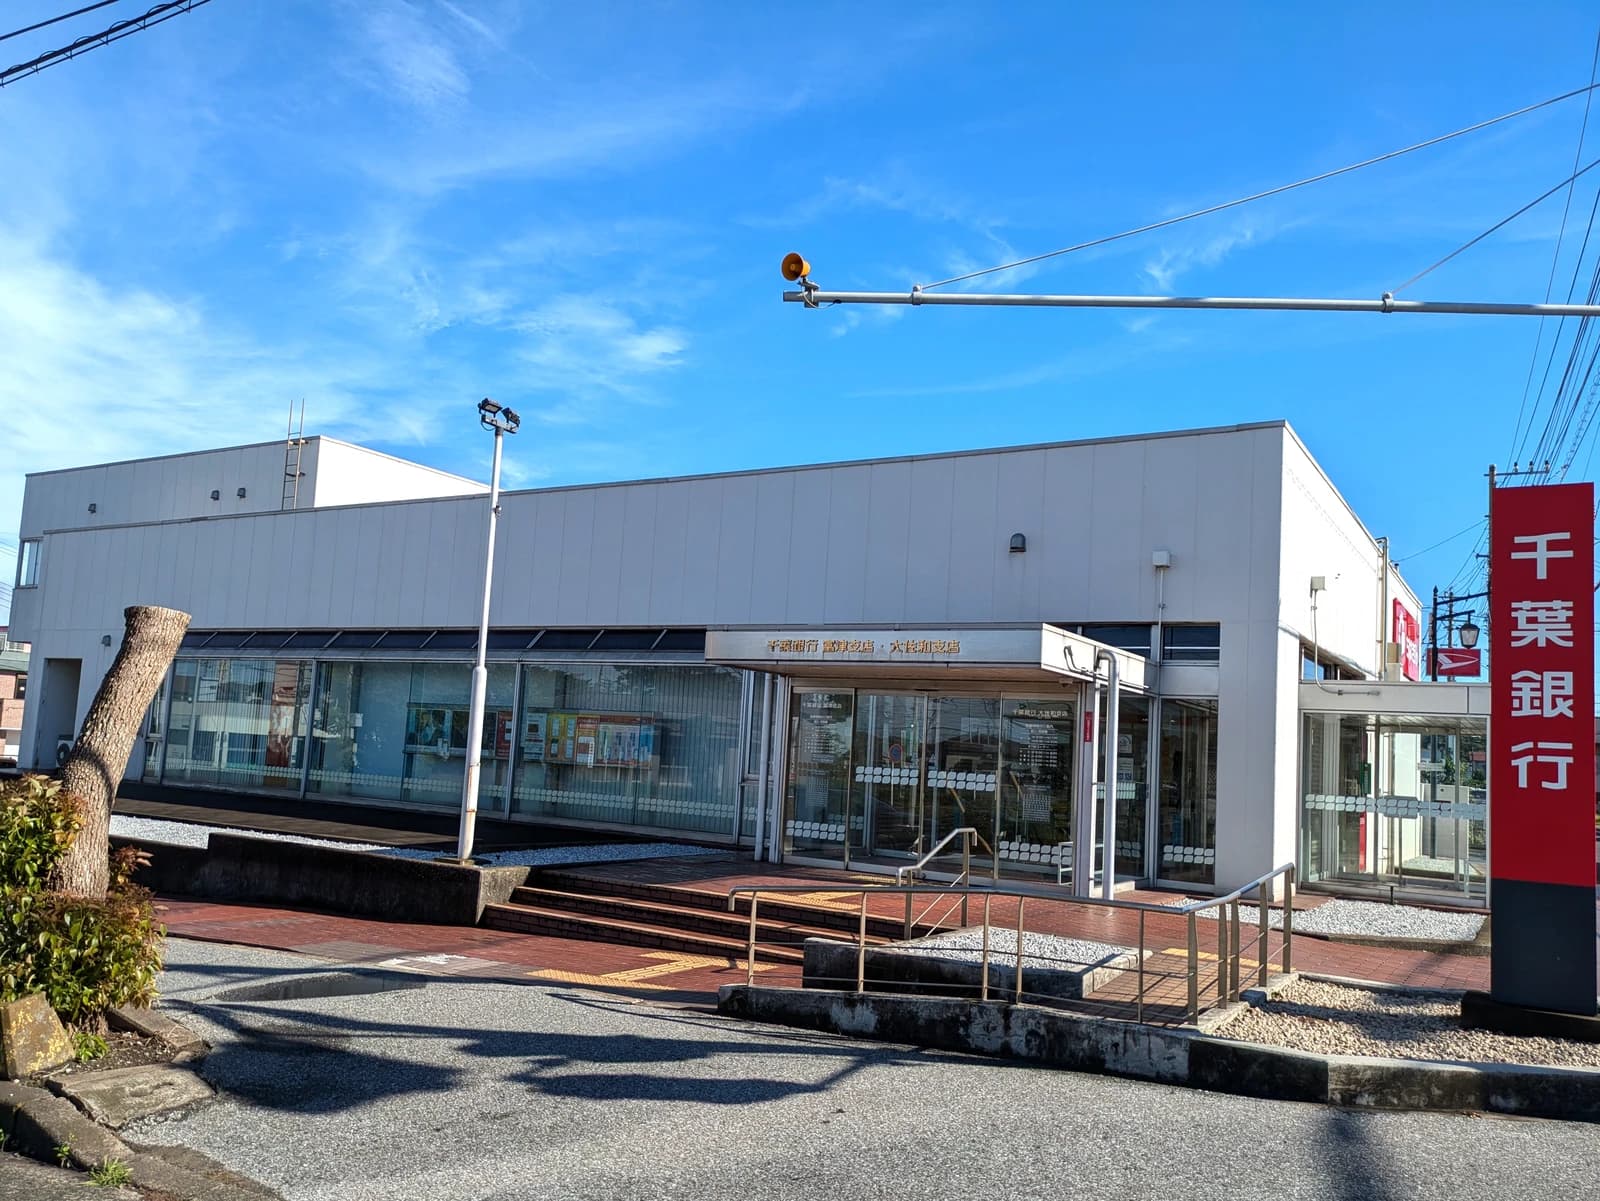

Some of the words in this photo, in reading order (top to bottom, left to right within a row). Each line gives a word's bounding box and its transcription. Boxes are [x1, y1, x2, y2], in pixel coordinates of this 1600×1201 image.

[767, 639, 819, 653] 千葉銀行
[1511, 532, 1573, 789] 千葉銀行
